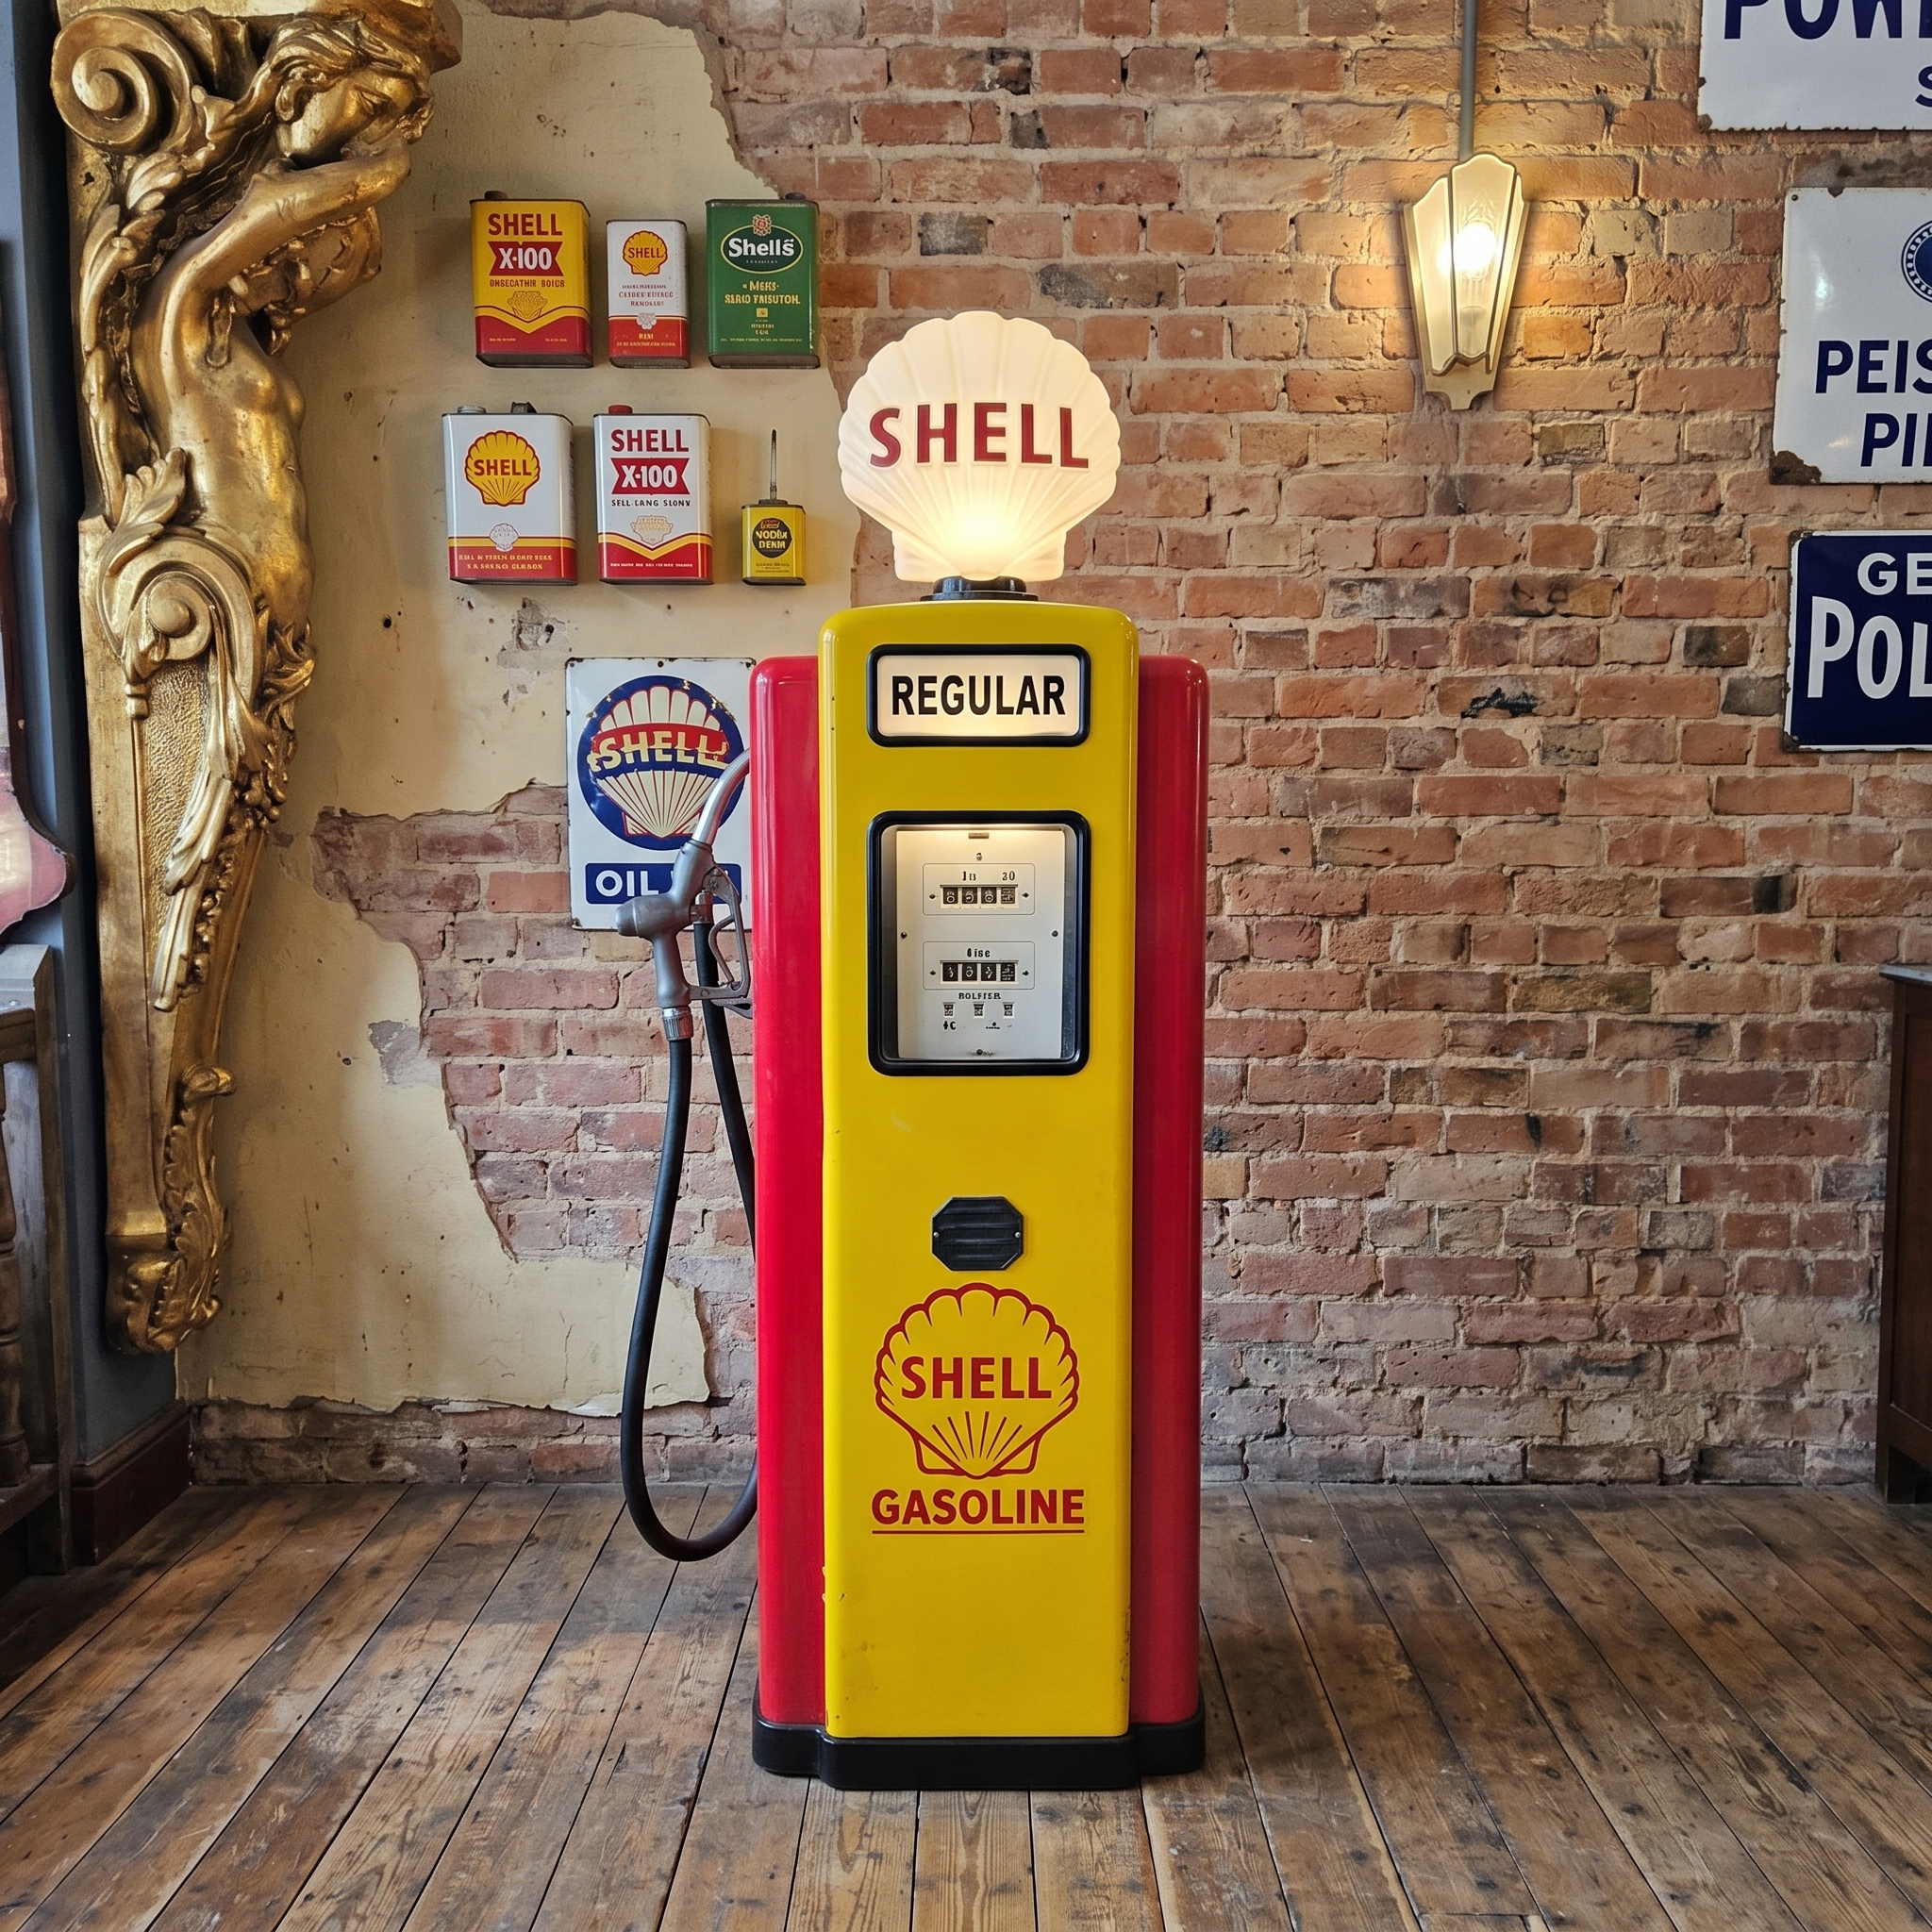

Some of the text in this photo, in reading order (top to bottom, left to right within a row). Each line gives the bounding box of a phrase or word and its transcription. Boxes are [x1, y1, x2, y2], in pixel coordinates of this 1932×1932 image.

[1724, 0, 1932, 40] POW
[488, 213, 562, 236] SHELL
[627, 247, 664, 258] SHELL
[610, 429, 689, 452] SHELL
[870, 402, 1089, 468] SHELL
[1860, 413, 1932, 467] PI
[474, 458, 532, 476] SHELL
[621, 465, 677, 488] X-100
[1857, 553, 1932, 595] GE
[1807, 596, 1932, 699] POL
[891, 675, 1066, 715] REGULAR
[598, 730, 730, 771] SHELL
[595, 870, 659, 897] OIL
[901, 1356, 1052, 1399] SHELL
[872, 1489, 1085, 1524] GASOLINE
